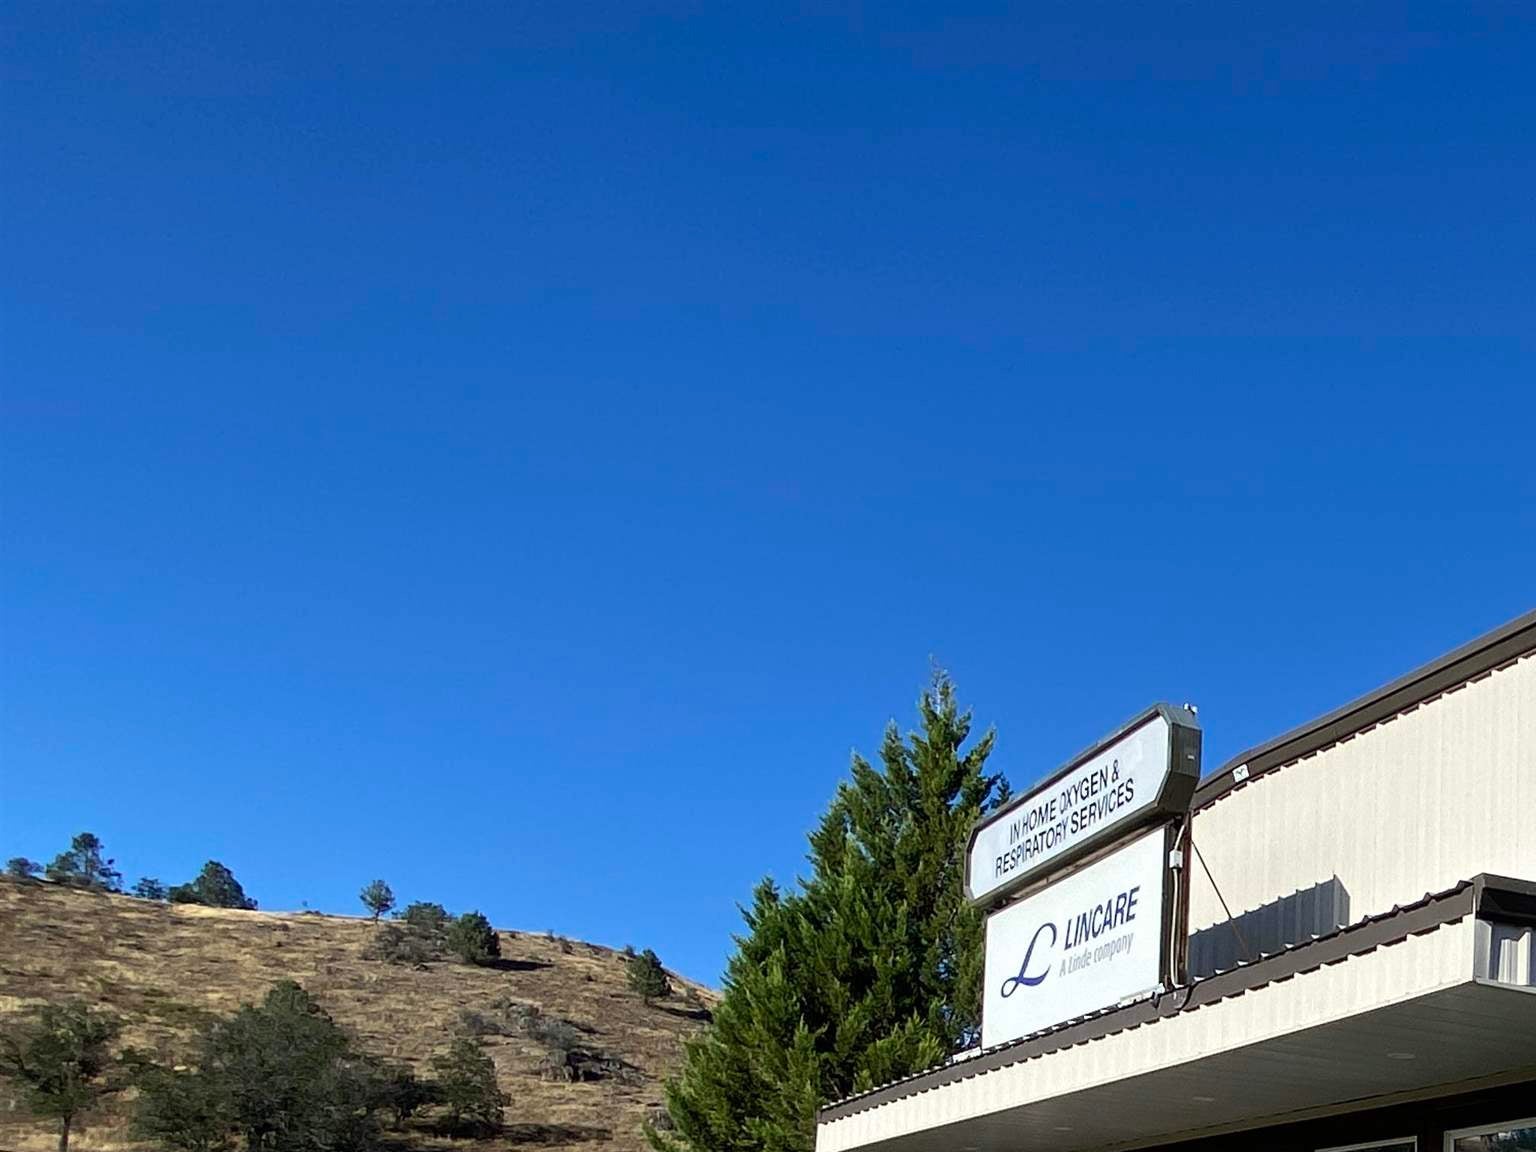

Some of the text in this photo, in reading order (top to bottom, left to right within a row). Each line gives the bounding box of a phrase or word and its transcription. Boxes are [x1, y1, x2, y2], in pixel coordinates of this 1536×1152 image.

[995, 778, 1134, 878] RESPIRATORY SERVICES
[1010, 759, 1120, 845] IN HOME OXYGEN &
[1059, 933, 1134, 977] A Linde company
[1064, 884, 1141, 951] LINCARE
